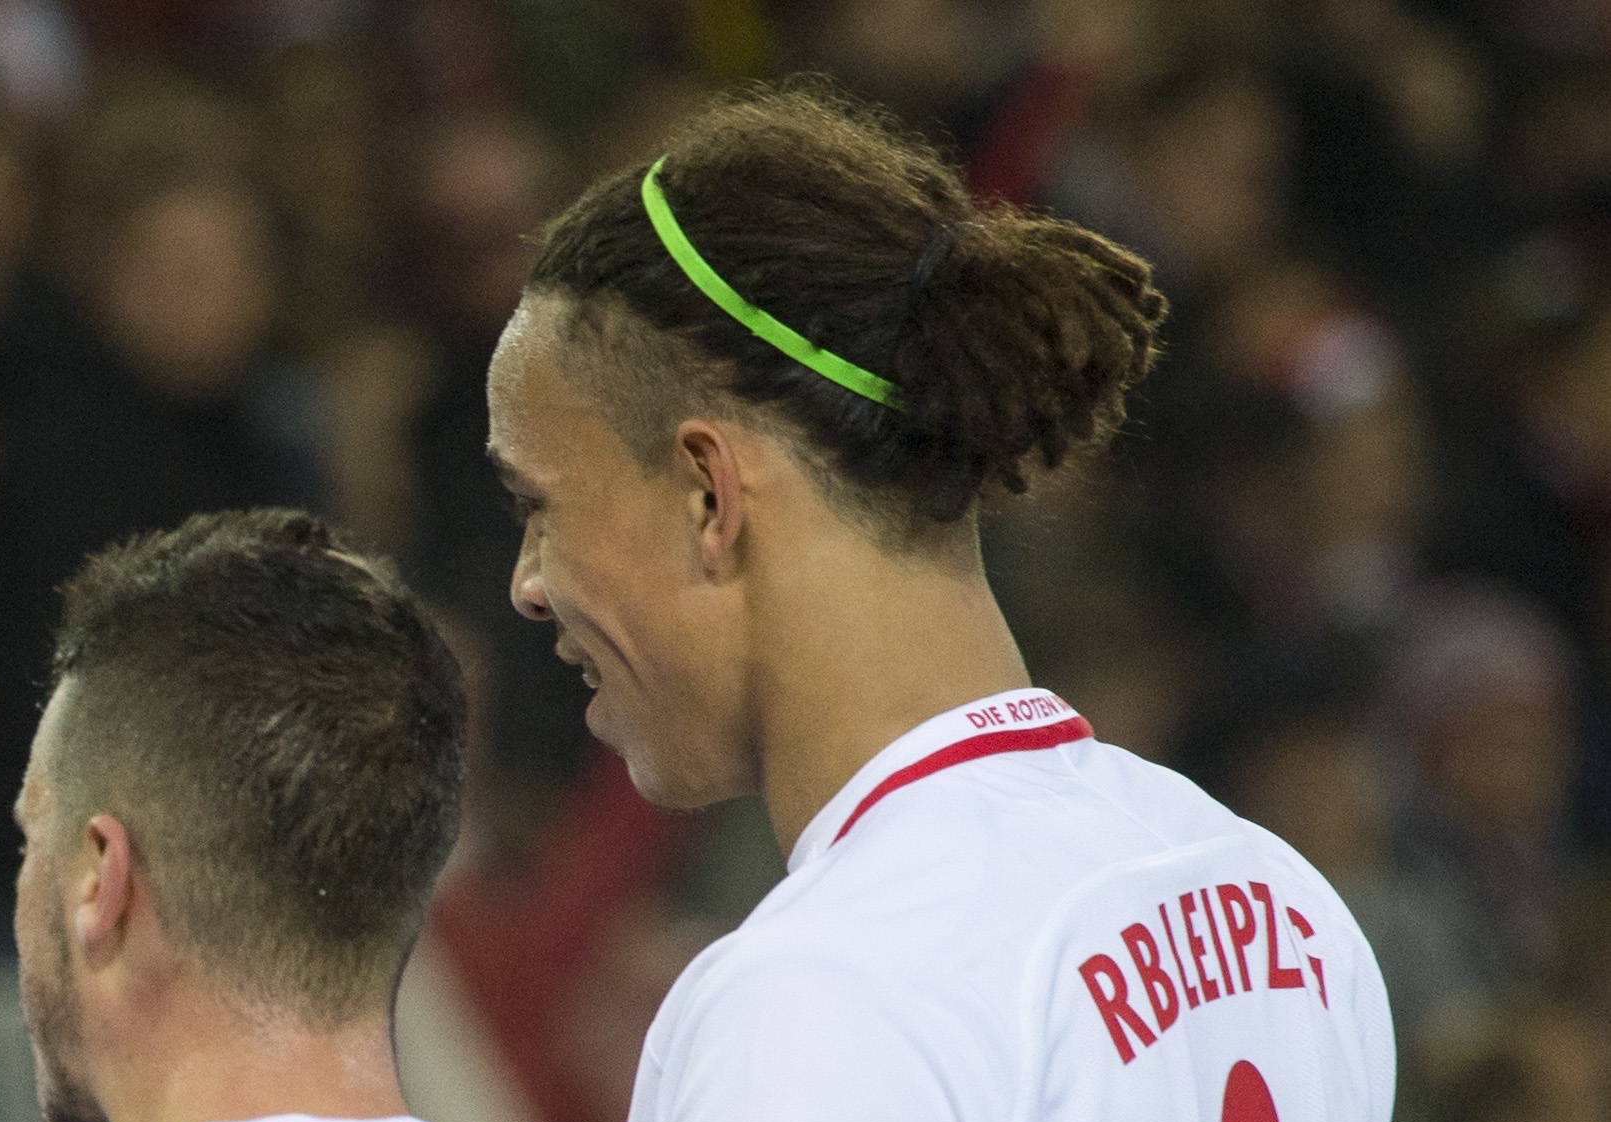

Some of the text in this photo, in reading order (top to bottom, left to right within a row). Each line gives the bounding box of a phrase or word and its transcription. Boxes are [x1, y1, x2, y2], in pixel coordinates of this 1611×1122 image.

[966, 706, 1005, 729] DIE
[1006, 696, 1059, 723] ROTEN
[1077, 922, 1180, 1066] RB
